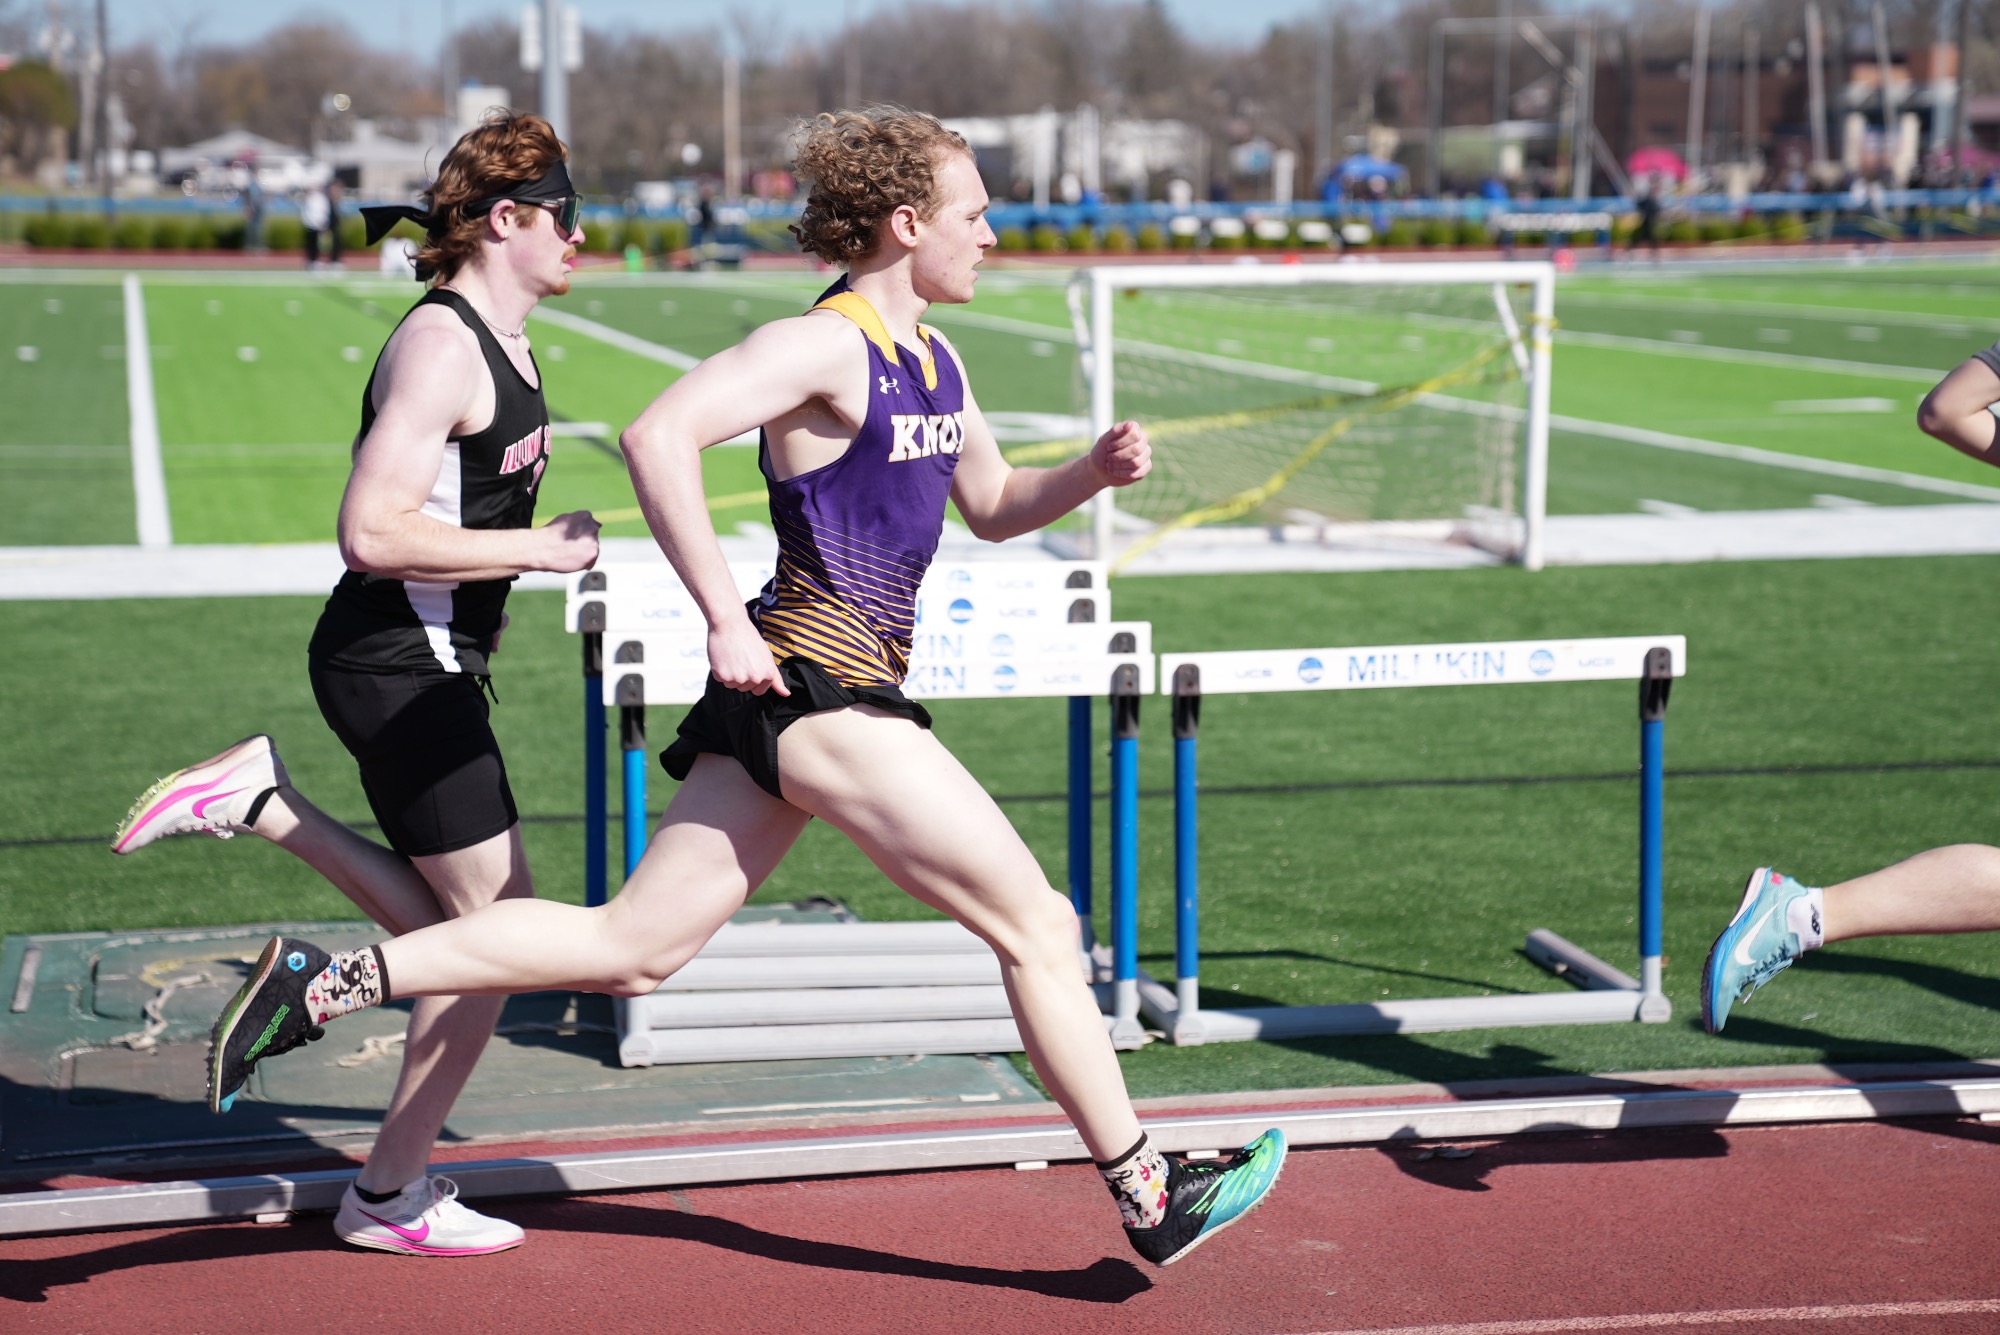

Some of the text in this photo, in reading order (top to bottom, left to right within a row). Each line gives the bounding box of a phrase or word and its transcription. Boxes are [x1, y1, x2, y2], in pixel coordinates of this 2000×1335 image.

[499, 425, 551, 475] ILLINOS
[641, 609, 682, 618] UCS
[998, 608, 1038, 617] UCS
[679, 648, 706, 657] UC
[1235, 669, 1274, 678] UCS
[1042, 675, 1082, 684] UCS
[681, 680, 706, 689] UC
